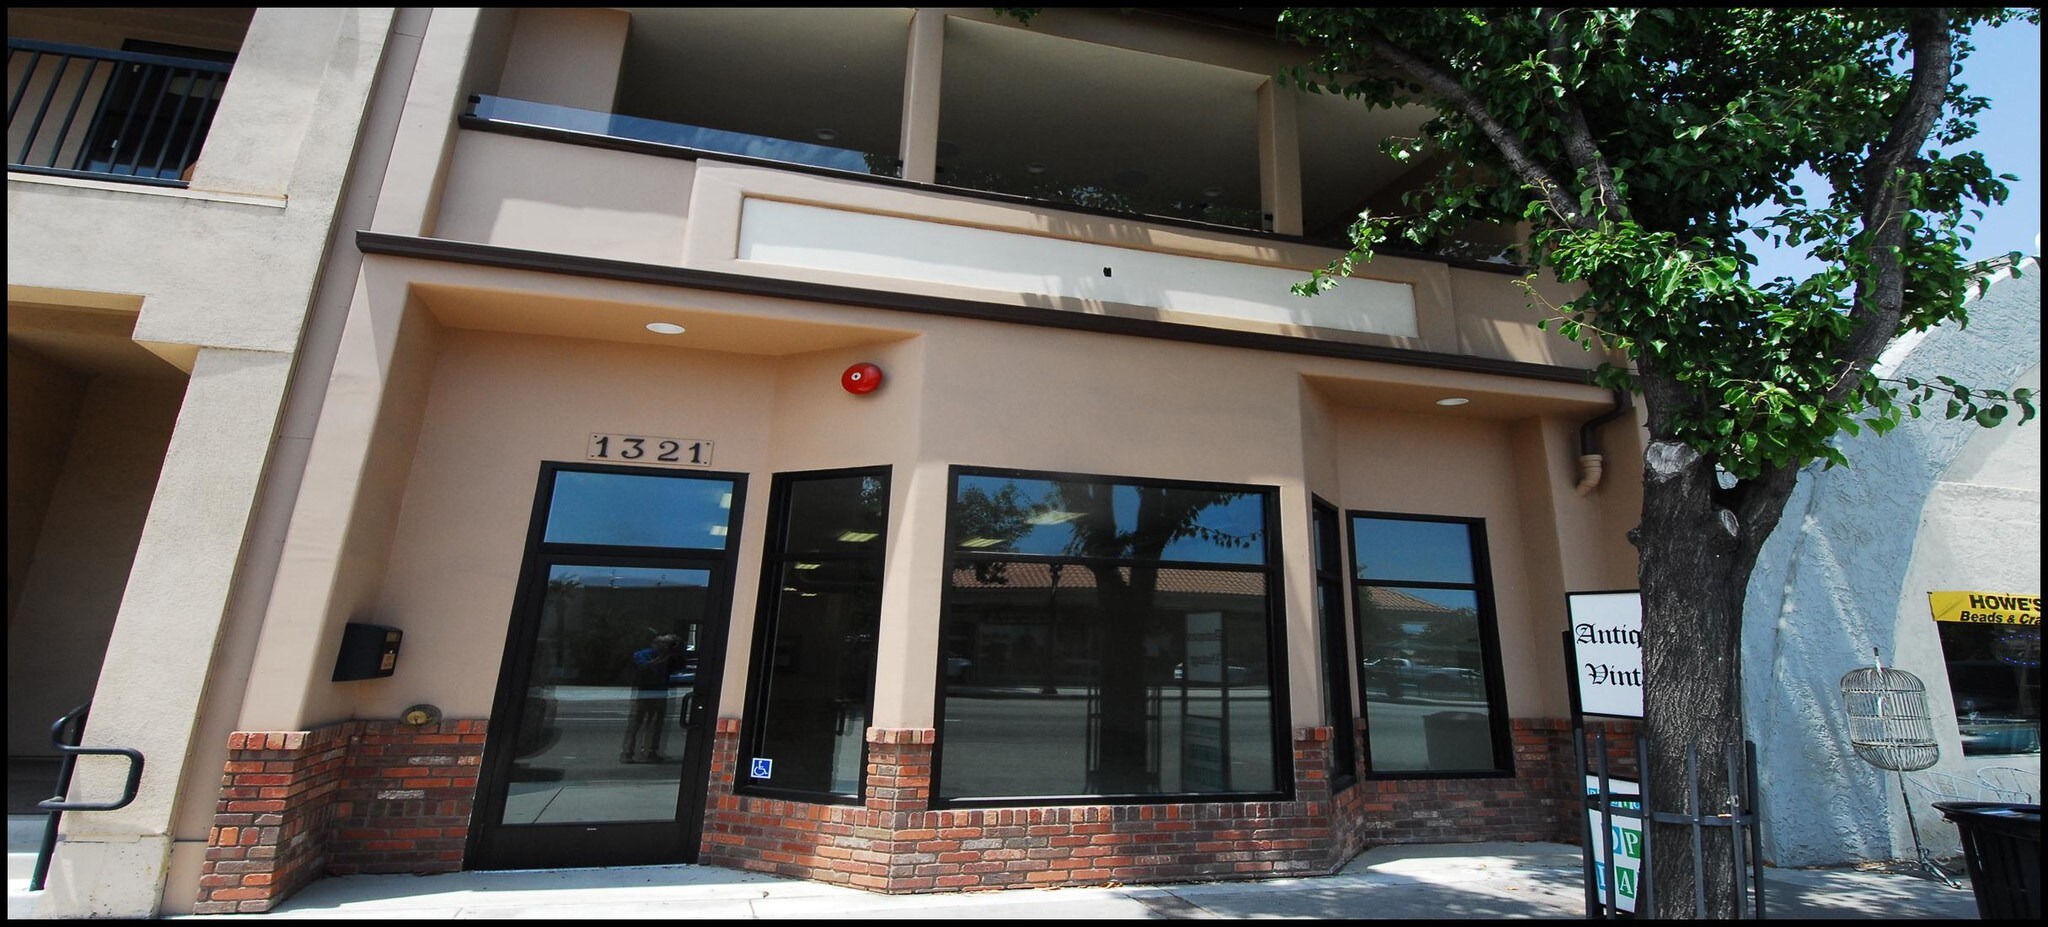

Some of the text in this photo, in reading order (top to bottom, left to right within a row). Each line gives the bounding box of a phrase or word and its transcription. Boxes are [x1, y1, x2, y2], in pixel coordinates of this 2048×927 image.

[596, 436, 701, 464] 1321
[1969, 594, 2040, 611] HOWE'S
[1960, 610, 2003, 622] Beads
[2006, 614, 2015, 624] &
